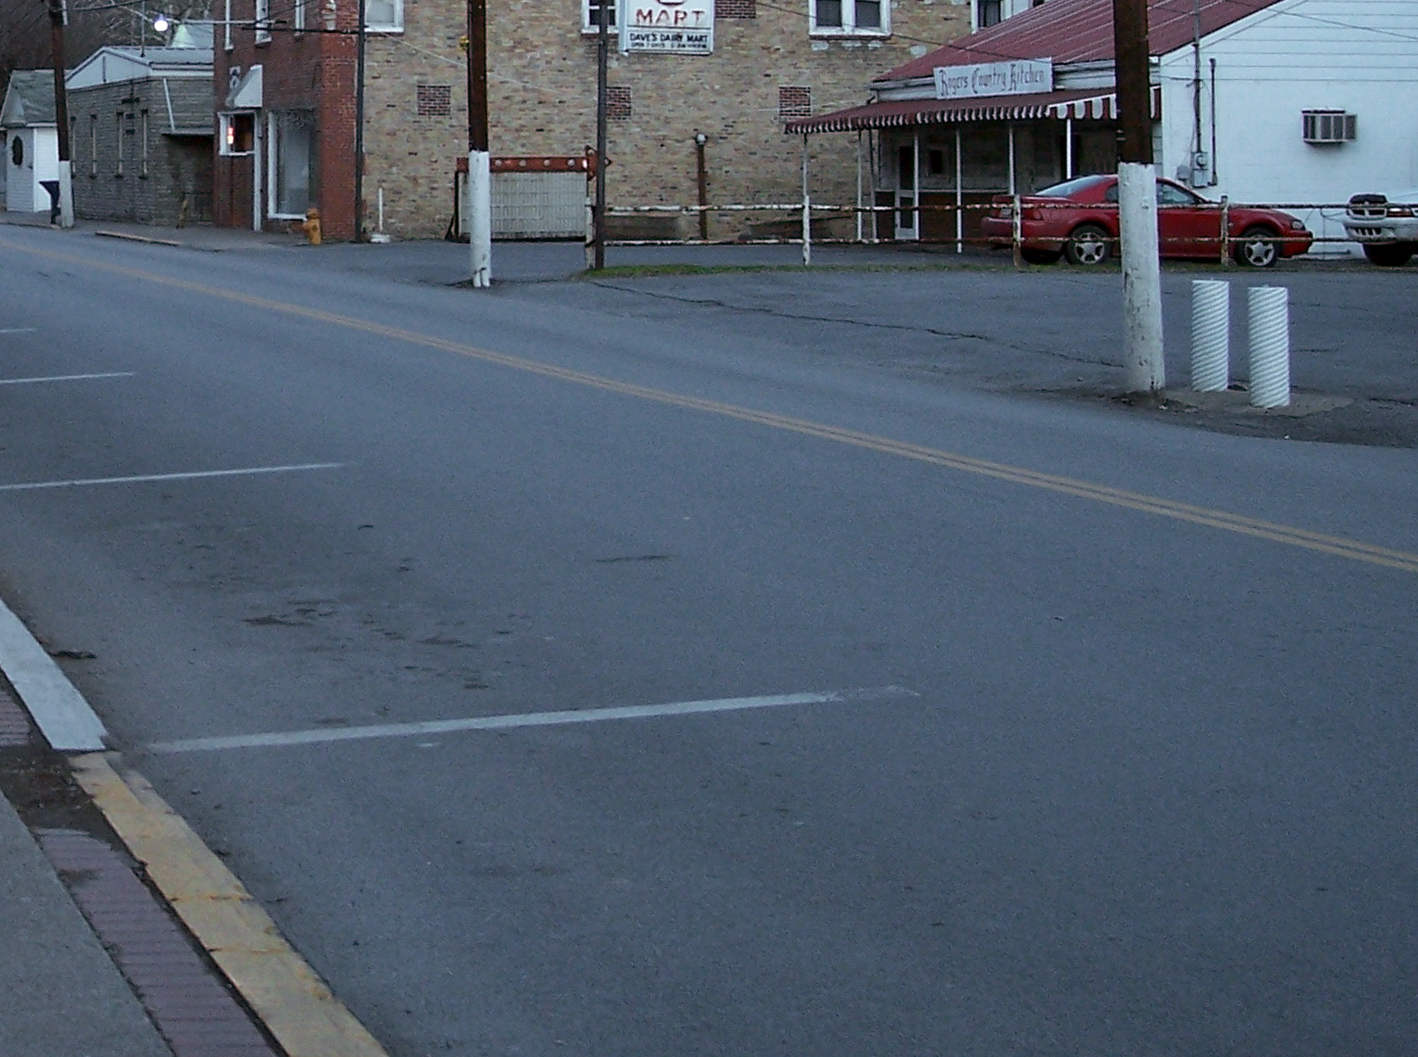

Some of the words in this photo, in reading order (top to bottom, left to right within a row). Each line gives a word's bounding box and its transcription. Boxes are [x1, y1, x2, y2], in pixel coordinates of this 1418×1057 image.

[635, 8, 705, 26] MART
[629, 33, 658, 42] DAVE'S
[660, 33, 684, 42] DAIRY
[686, 34, 709, 42] MART
[971, 67, 1007, 94] Country
[1008, 63, 1045, 91] Kitchen
